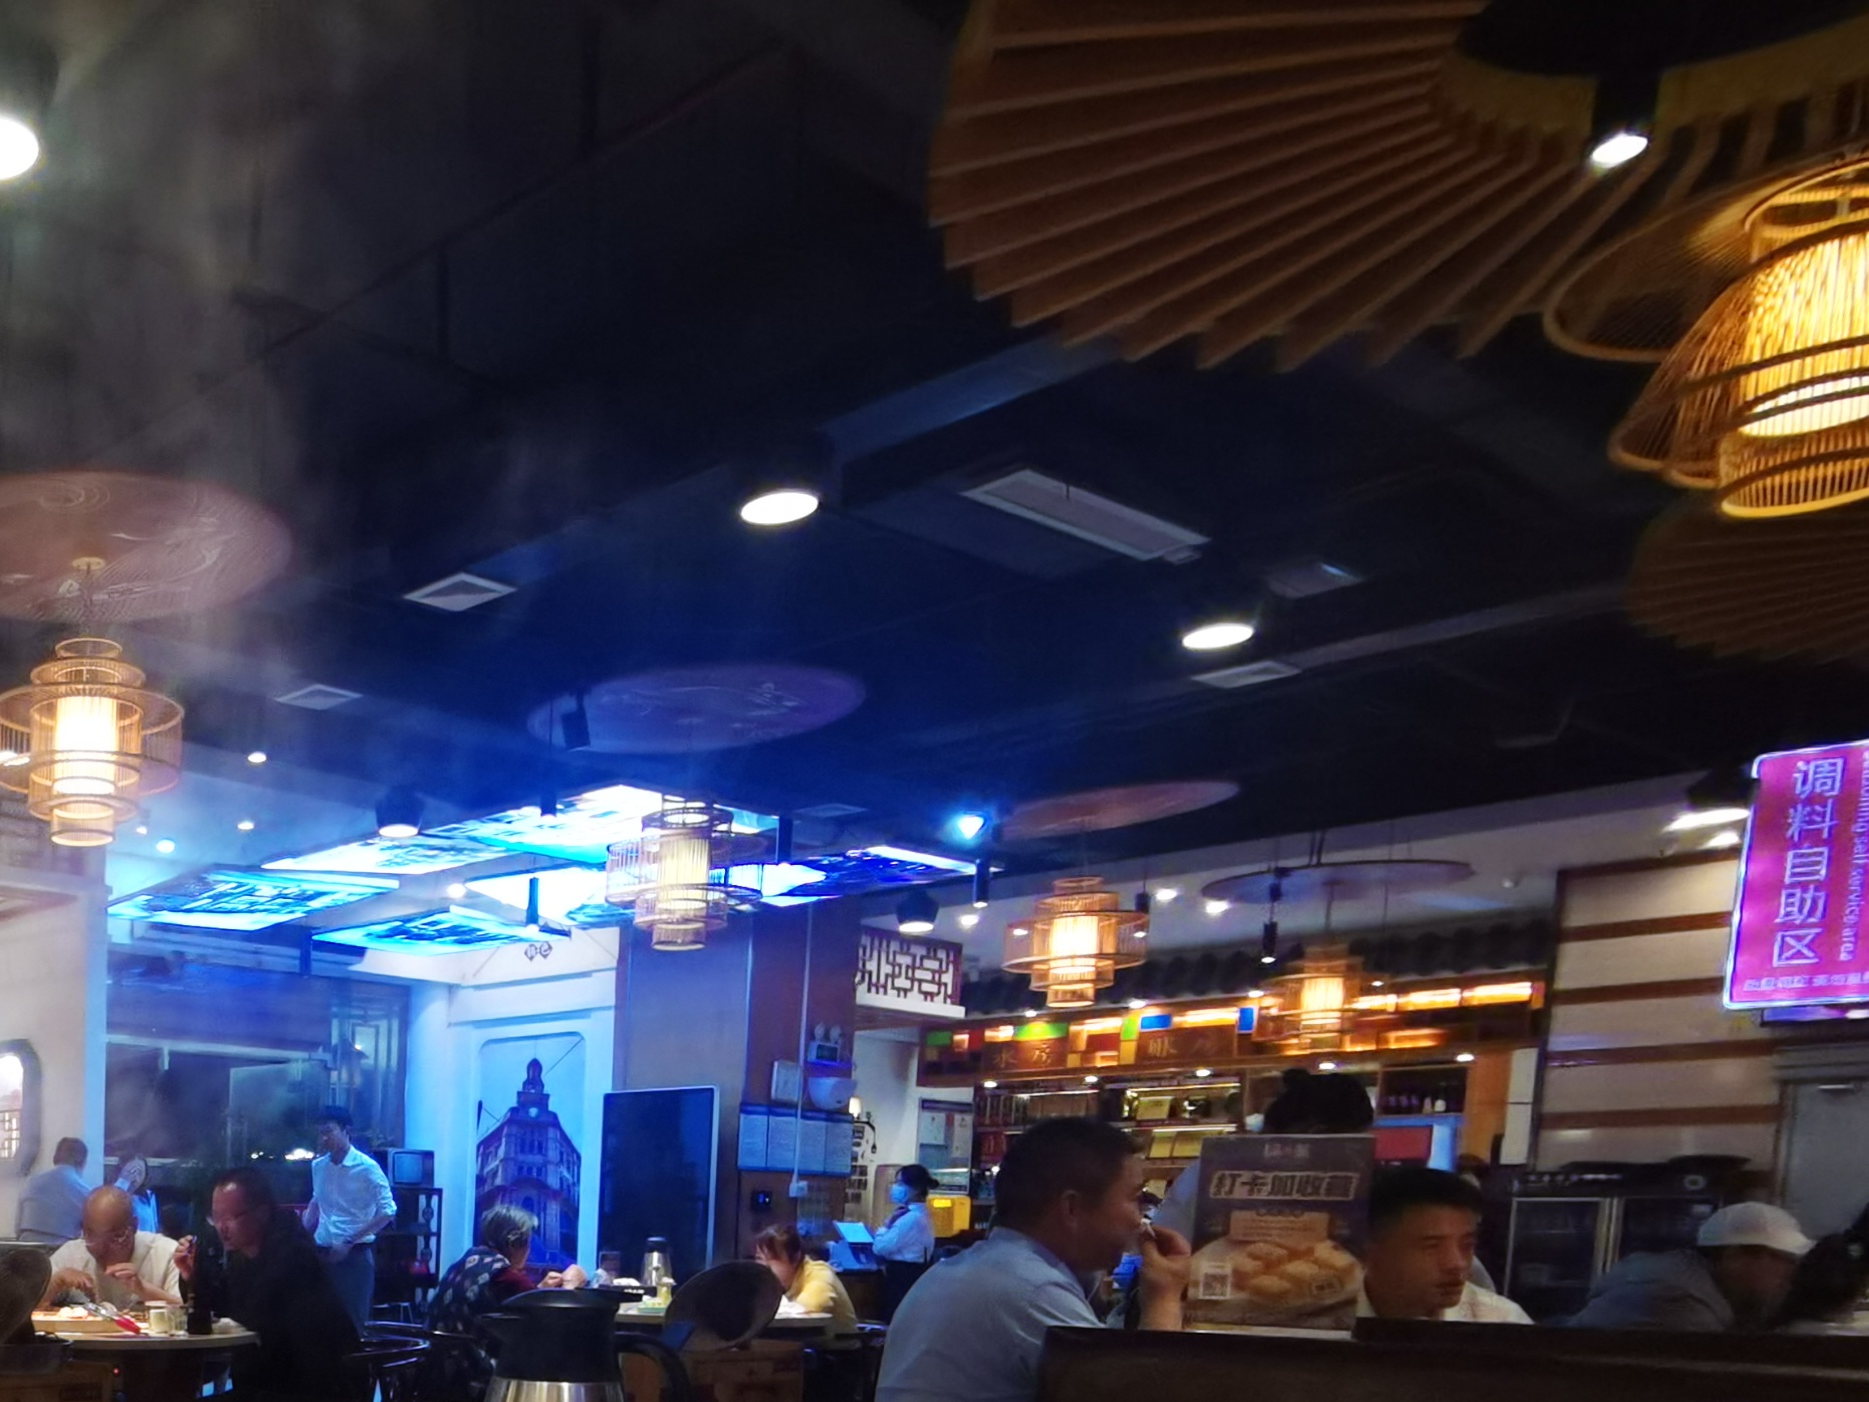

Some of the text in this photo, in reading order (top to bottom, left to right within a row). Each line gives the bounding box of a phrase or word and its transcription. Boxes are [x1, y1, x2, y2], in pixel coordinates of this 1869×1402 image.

[1773, 757, 1844, 967] 调料自助区
